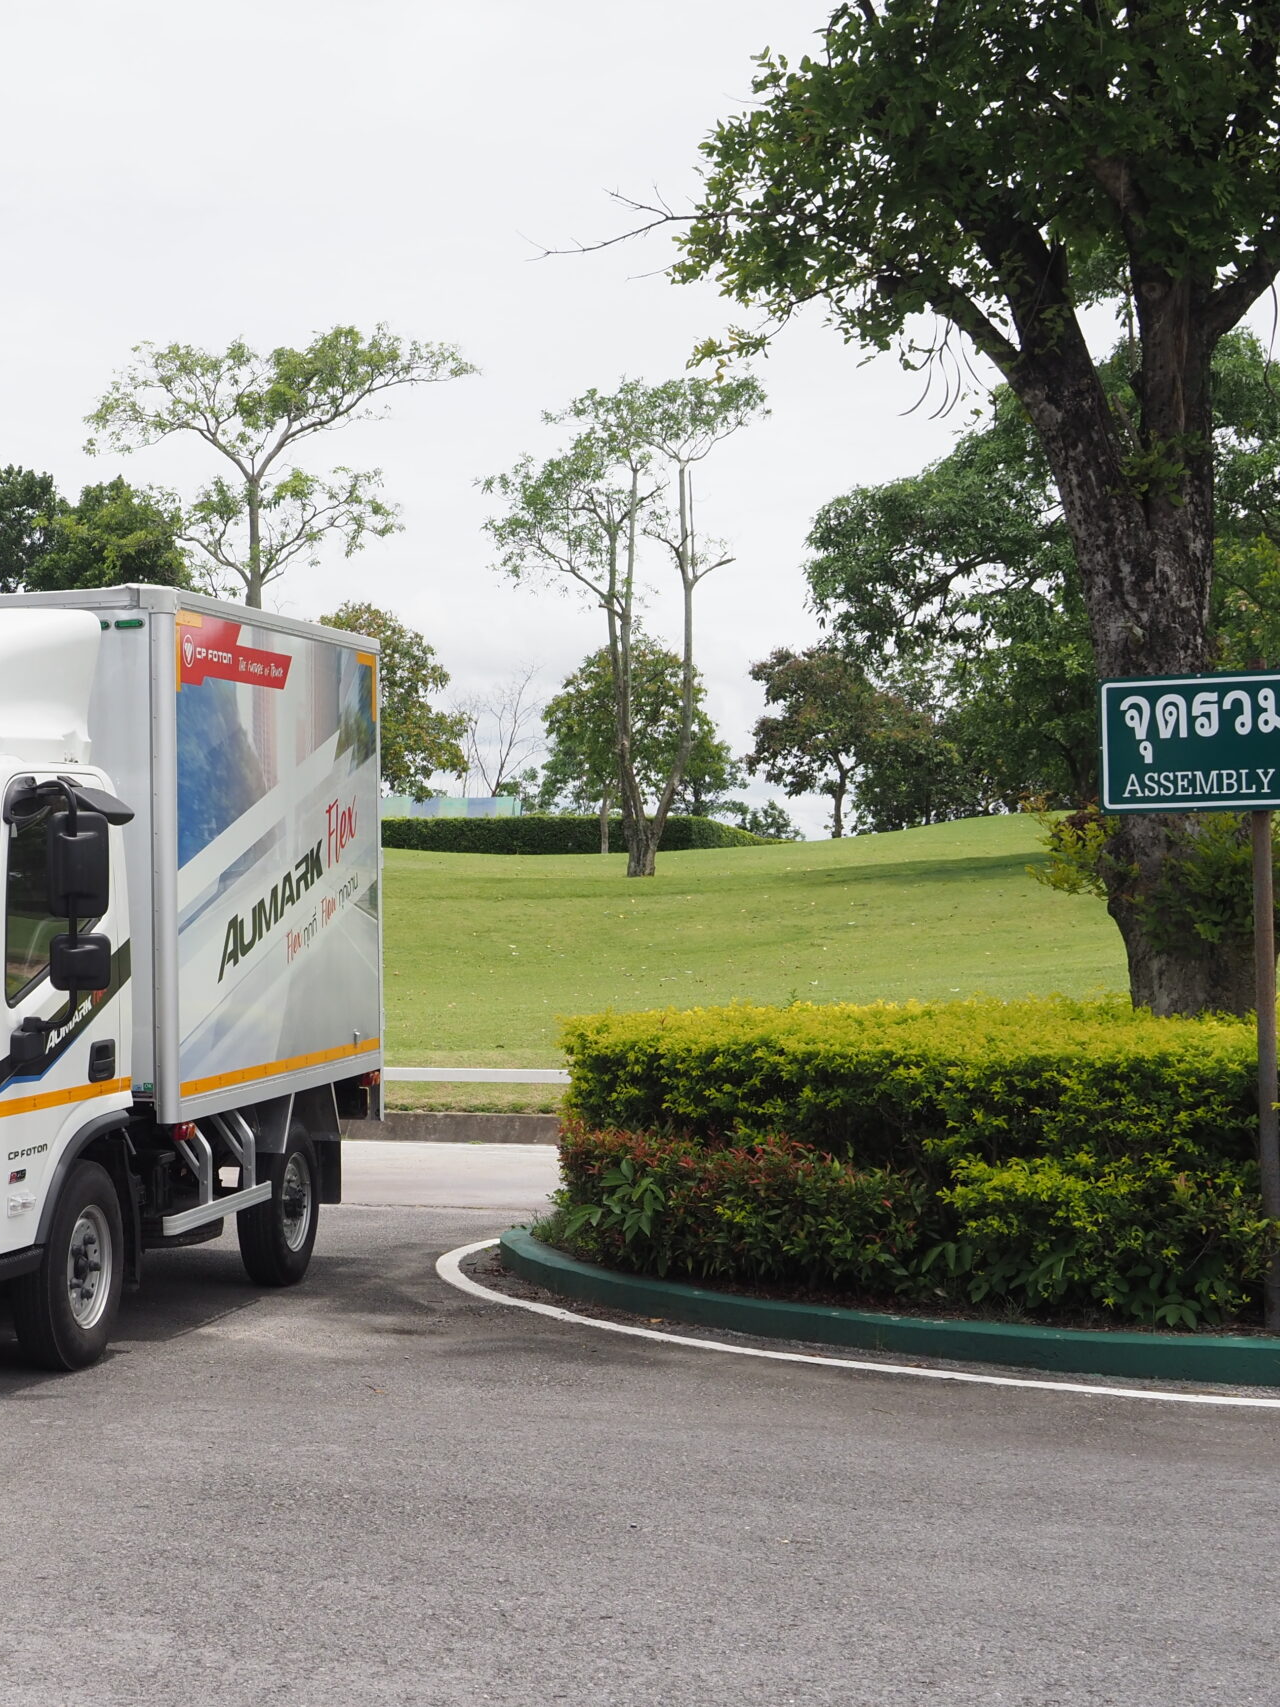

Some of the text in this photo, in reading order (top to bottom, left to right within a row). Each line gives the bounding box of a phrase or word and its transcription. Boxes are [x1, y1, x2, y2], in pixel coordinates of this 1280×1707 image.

[195, 647, 232, 664] CP FOTON
[1122, 768, 1276, 798] ASSEMBLY
[217, 794, 358, 985] AUMARK Flex
[7, 1143, 48, 1161] CP FOTON
